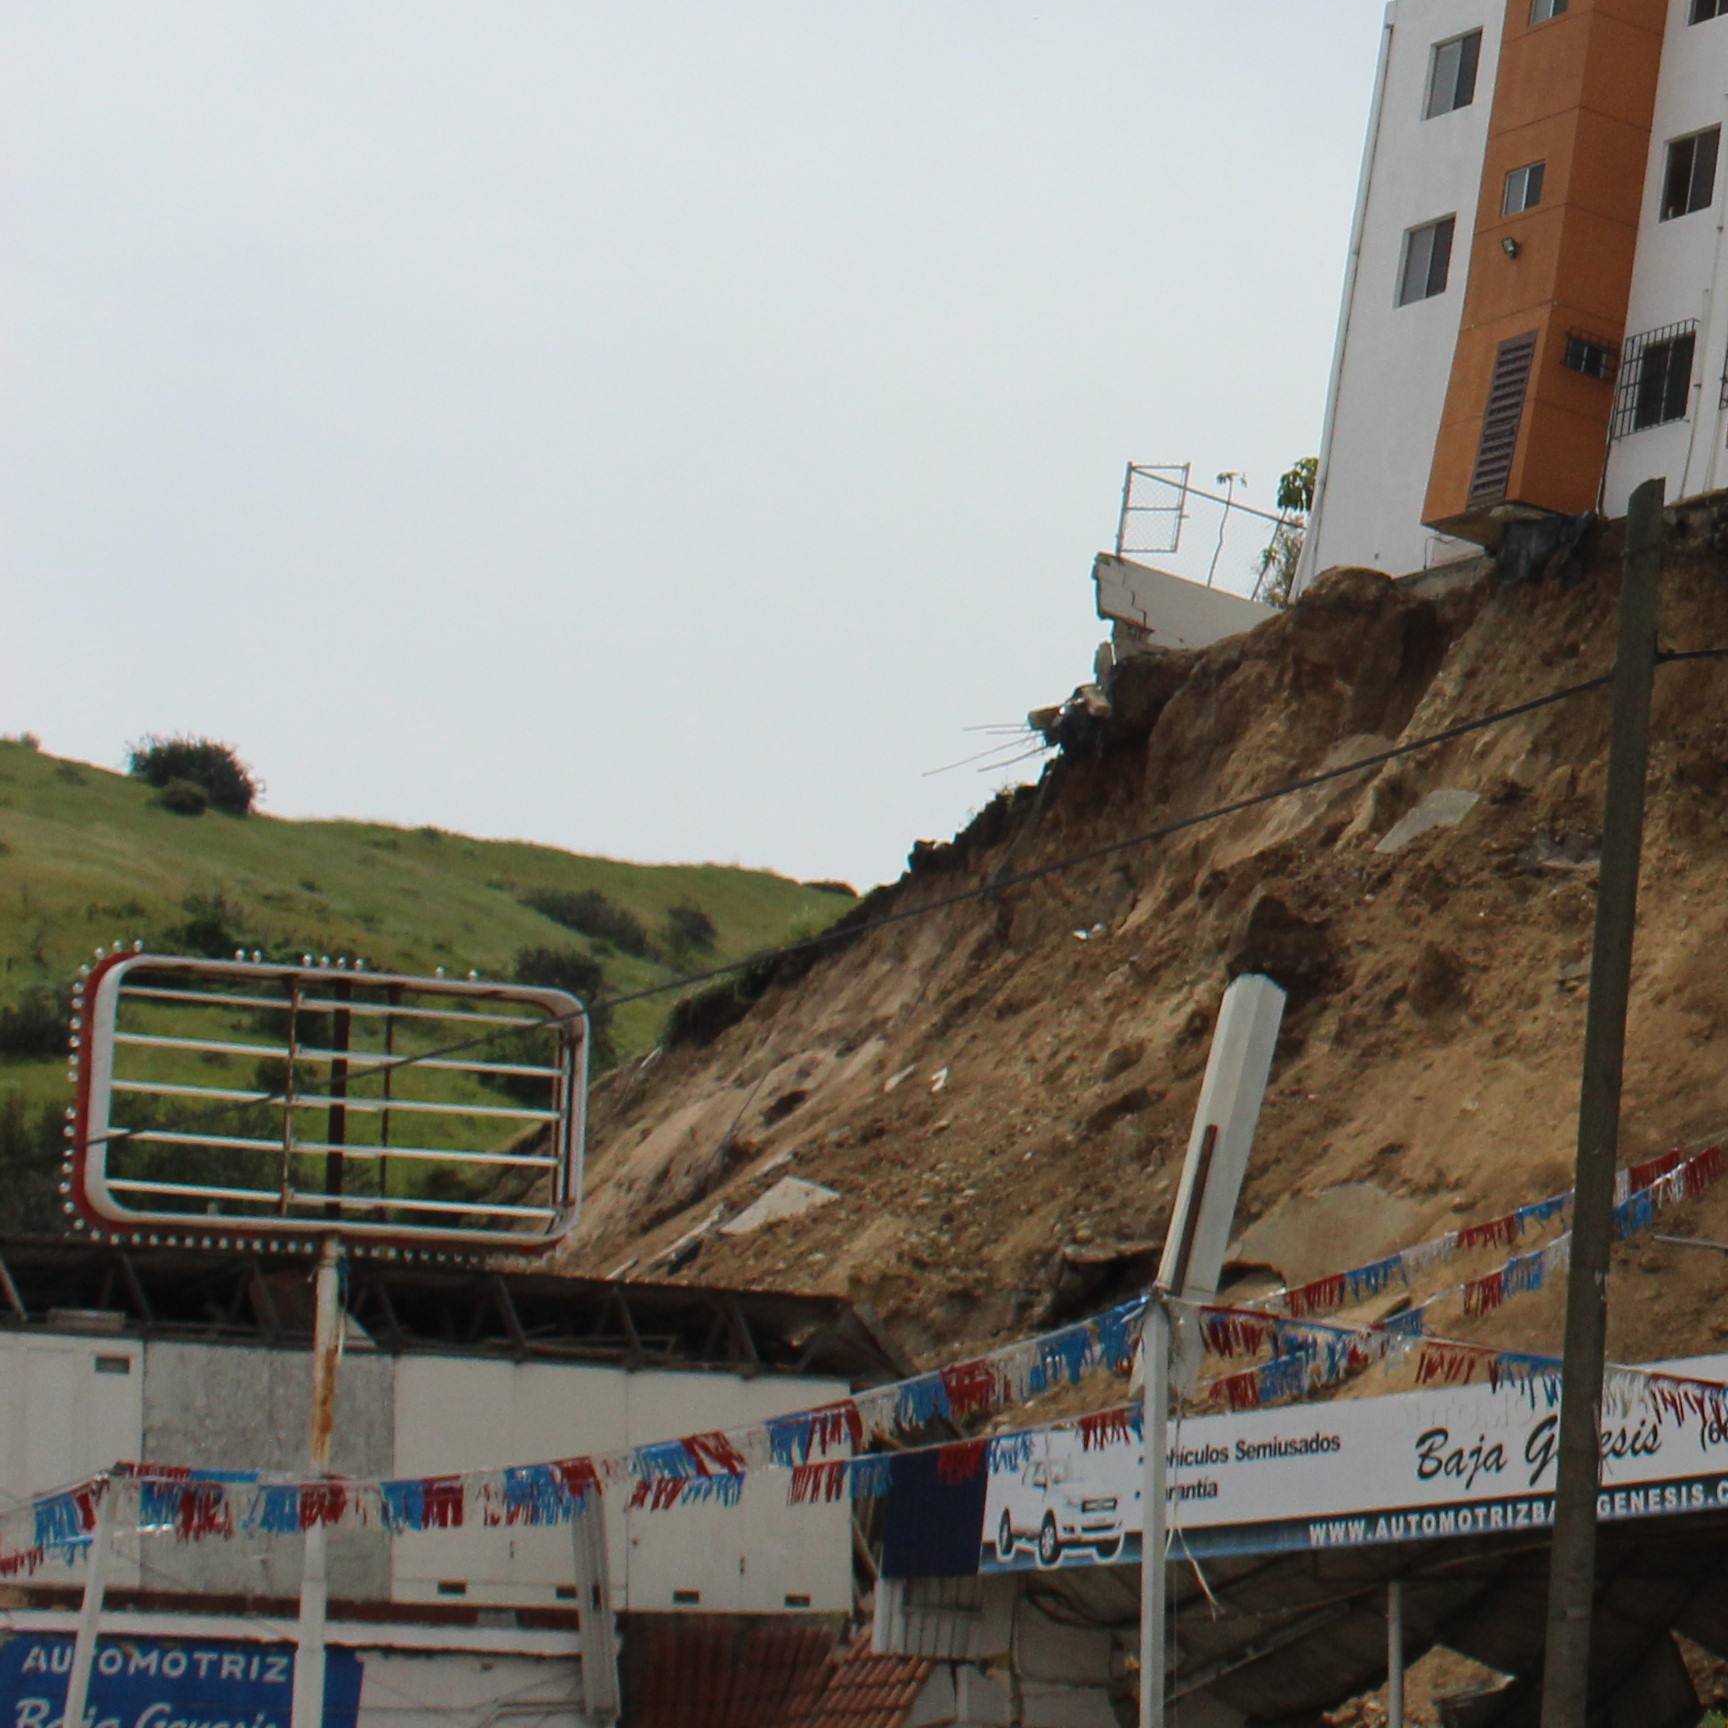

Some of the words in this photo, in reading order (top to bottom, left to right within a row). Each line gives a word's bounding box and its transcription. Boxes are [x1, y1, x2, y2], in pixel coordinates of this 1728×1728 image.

[1166, 1443, 1229, 1468] hículos
[1235, 1432, 1341, 1461] Semiusados
[1415, 1427, 1507, 1490] Baja
[1525, 1413, 1662, 1487] Gesis
[1165, 1476, 1218, 1500] rantía
[22, 1645, 289, 1683] AUOMOTRIZ
